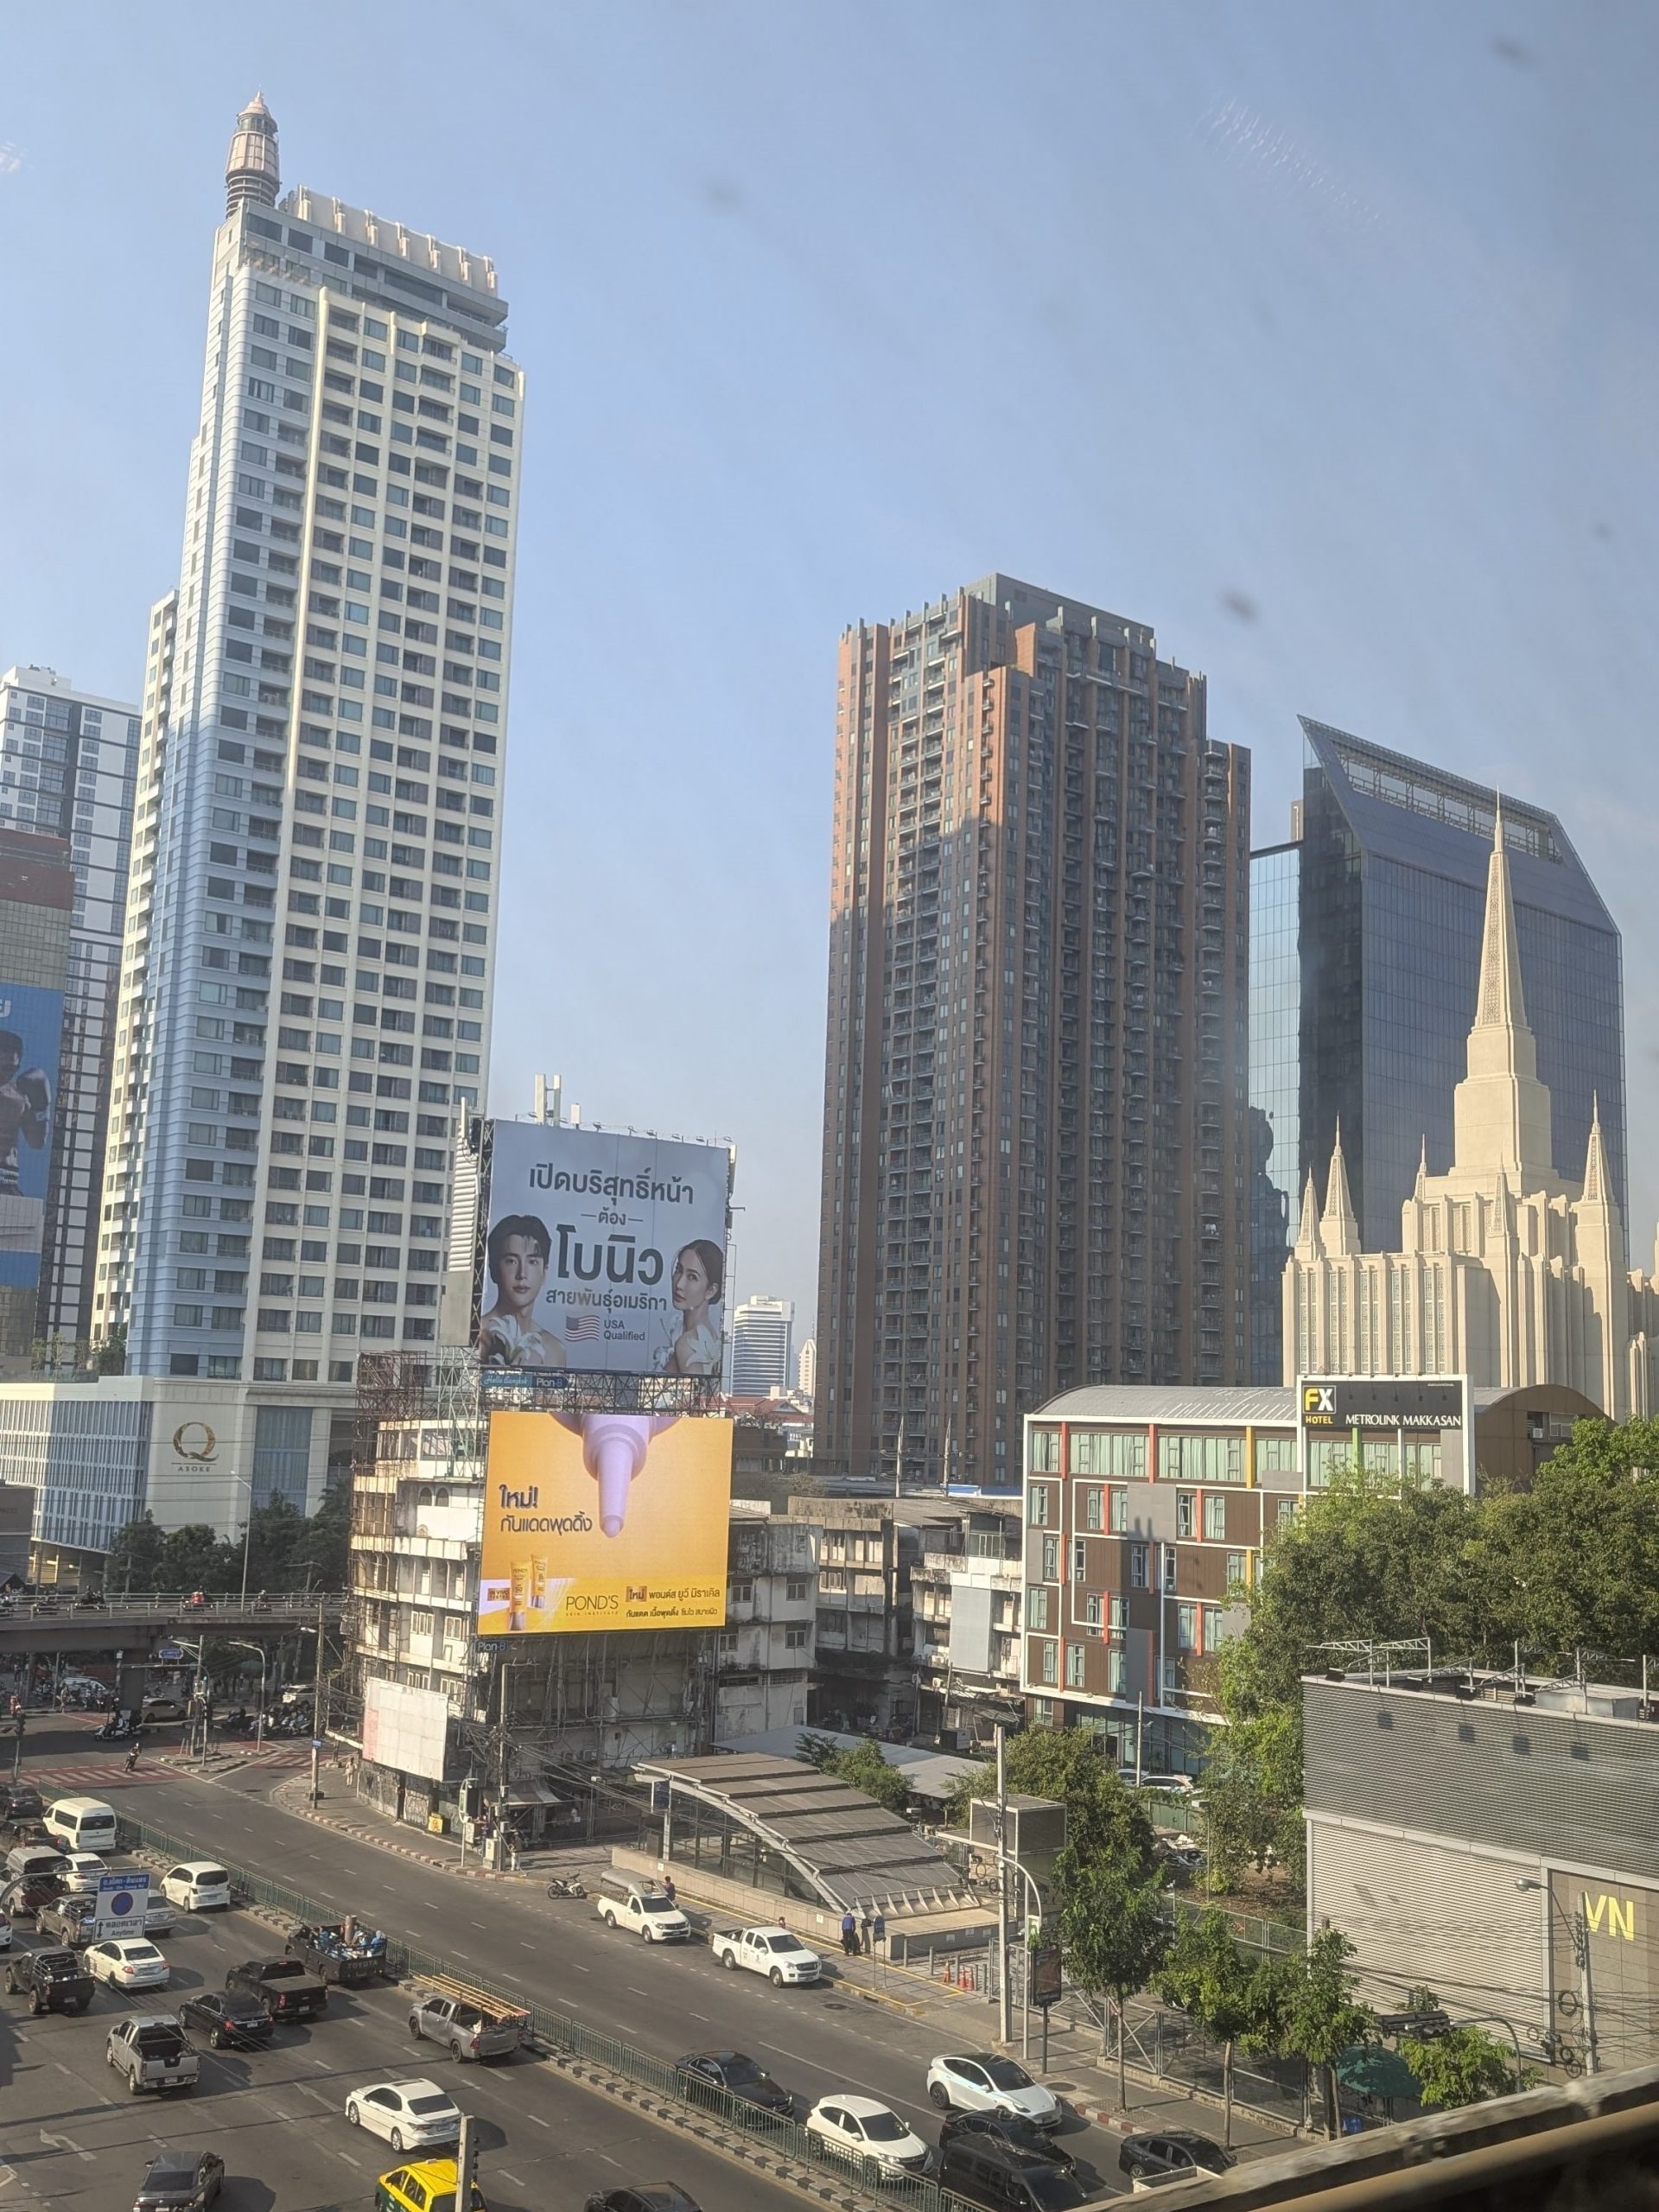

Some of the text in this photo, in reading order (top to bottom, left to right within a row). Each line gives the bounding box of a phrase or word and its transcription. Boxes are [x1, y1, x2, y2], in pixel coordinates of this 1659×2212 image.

[529, 1162, 694, 1206] เปิดบริสุทธิ์หน้า
[598, 1206, 626, 1225] ต้อง
[556, 1224, 664, 1285] โบนิว
[545, 1287, 667, 1313] สายพันธุ์อเมริกา
[604, 1319, 625, 1330] USA
[604, 1331, 645, 1341] Qualified
[537, 1377, 556, 1386] Plan
[1305, 1388, 1334, 1412] FX
[1306, 1415, 1333, 1424] HOTEL
[1345, 1414, 1462, 1427] METROLINK MAKKASAN
[173, 1421, 219, 1463] Q
[499, 1484, 538, 1509] ใหม่!
[500, 1510, 593, 1536] กันแดดพุดดิ้ง
[566, 1594, 619, 1611] POND'S
[629, 1588, 645, 1599] ใหม่
[677, 1587, 690, 1601] ยูวี
[477, 1642, 506, 1651] Plan B
[348, 1961, 378, 1969] TOYOTA
